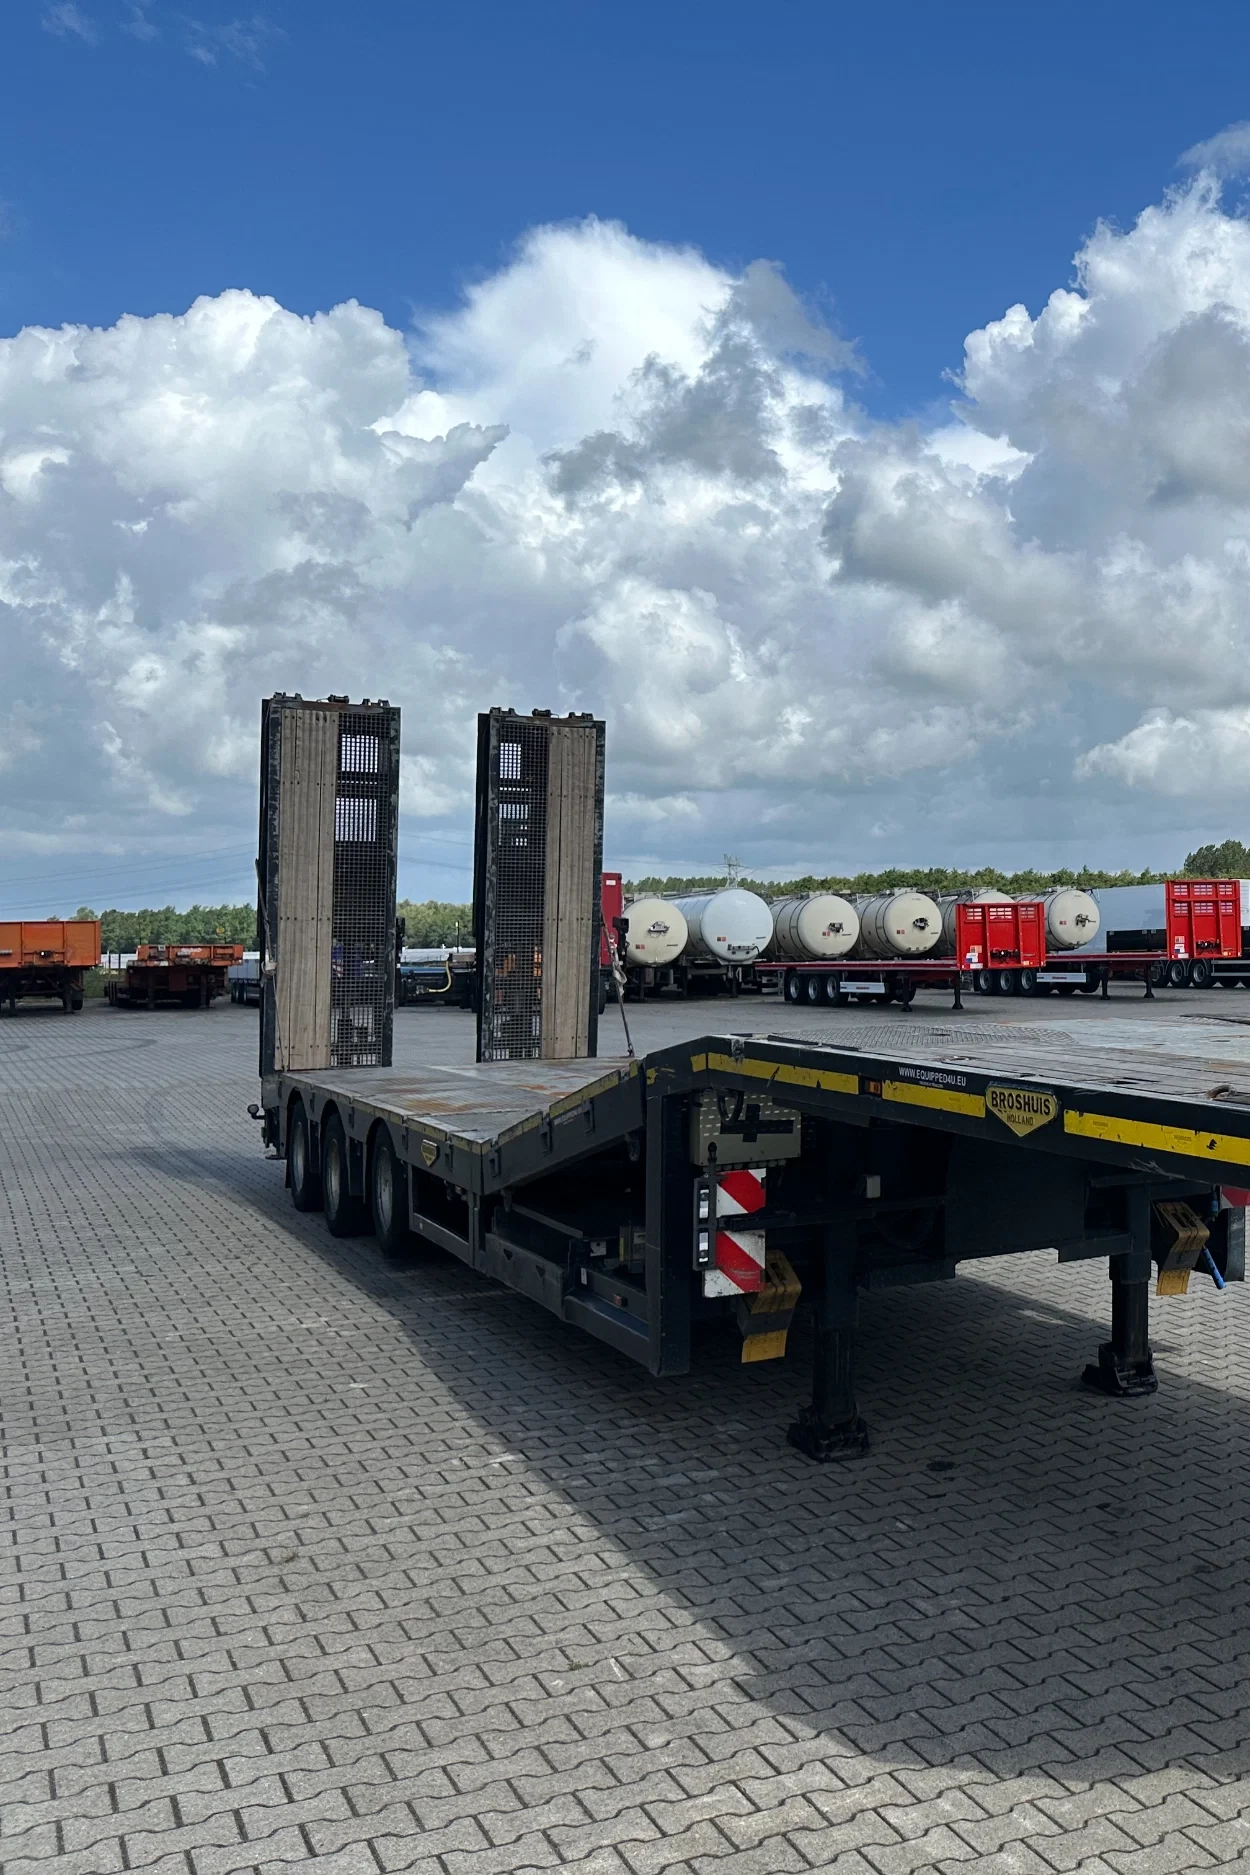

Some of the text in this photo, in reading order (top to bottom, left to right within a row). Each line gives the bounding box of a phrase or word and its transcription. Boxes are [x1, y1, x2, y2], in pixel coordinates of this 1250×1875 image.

[898, 1066, 967, 1087] WWW.EQUIPPED4U.EU
[991, 1090, 1051, 1116] BROSHUIS
[1006, 1113, 1034, 1126] HOLLAND
